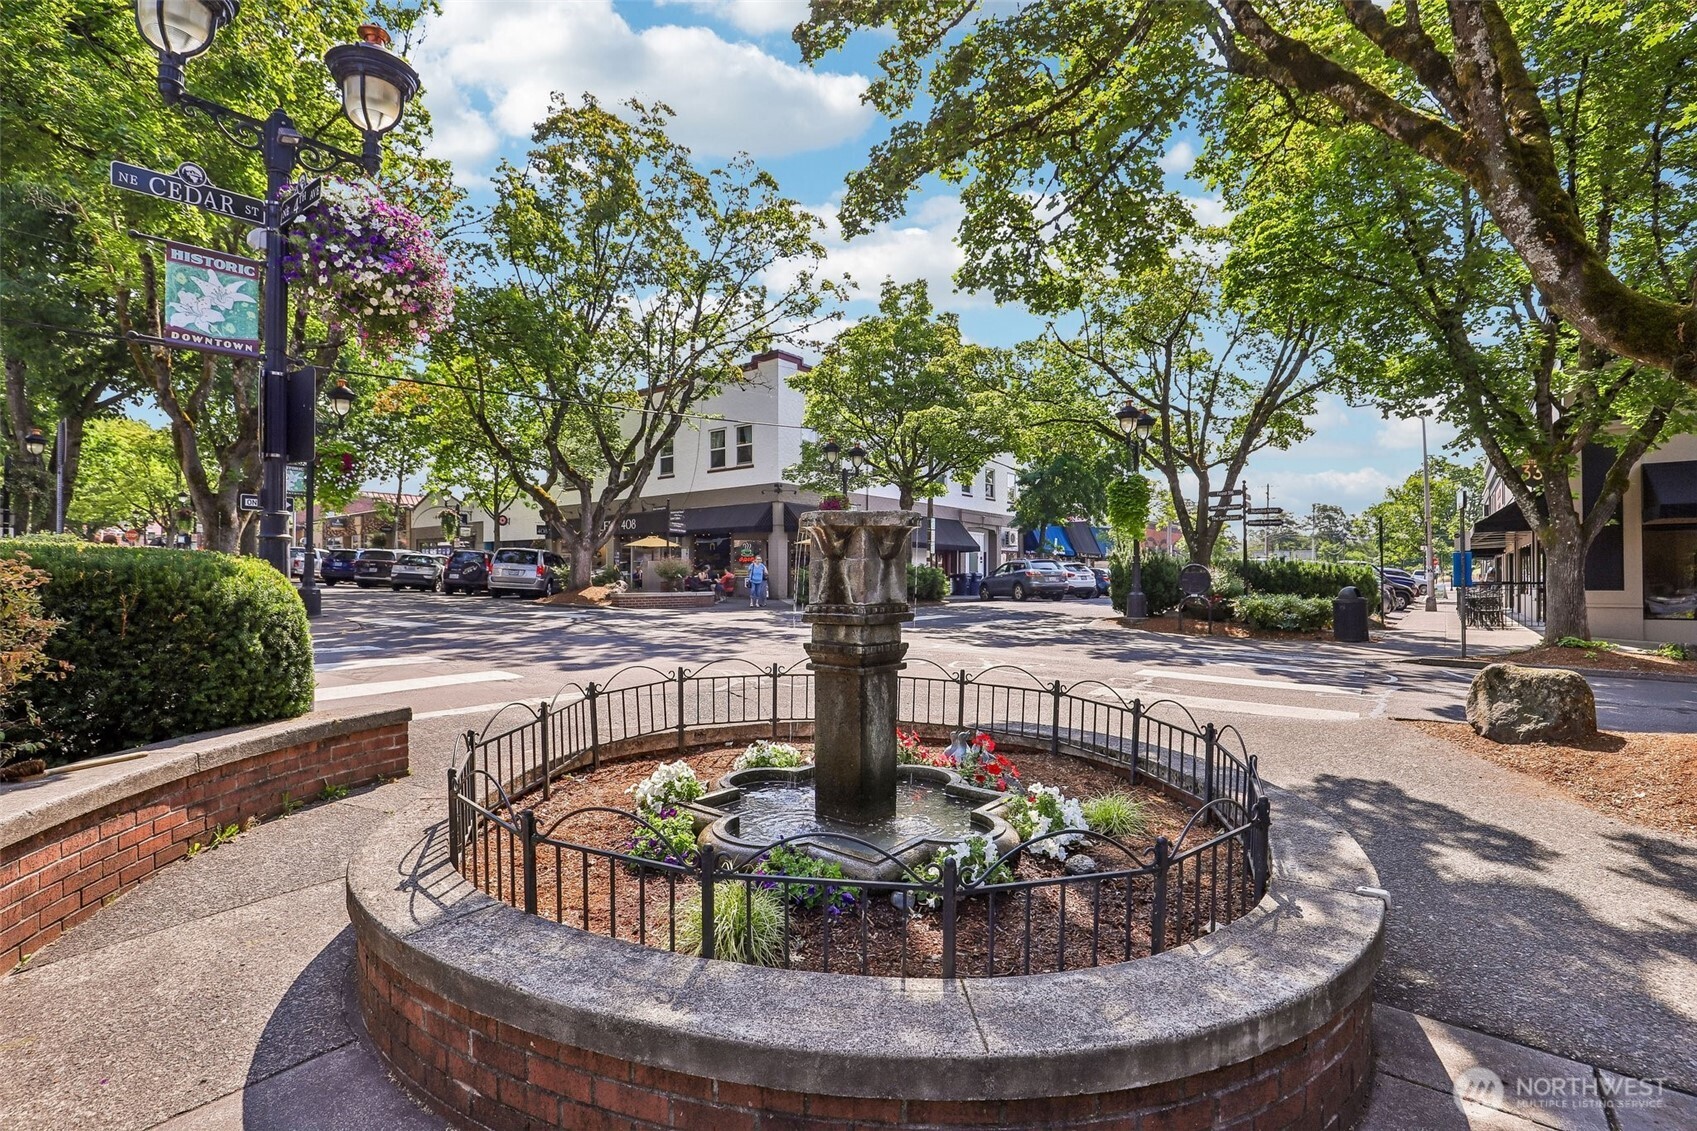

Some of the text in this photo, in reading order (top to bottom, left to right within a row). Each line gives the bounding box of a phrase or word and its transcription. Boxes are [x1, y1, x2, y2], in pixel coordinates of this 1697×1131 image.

[118, 171, 259, 217] NE CEDAR ST
[282, 206, 290, 219] NE
[309, 186, 320, 201] AVE
[170, 248, 256, 277] HISTORIC
[170, 331, 253, 353] DOWNTOWN
[620, 518, 637, 530] 408
